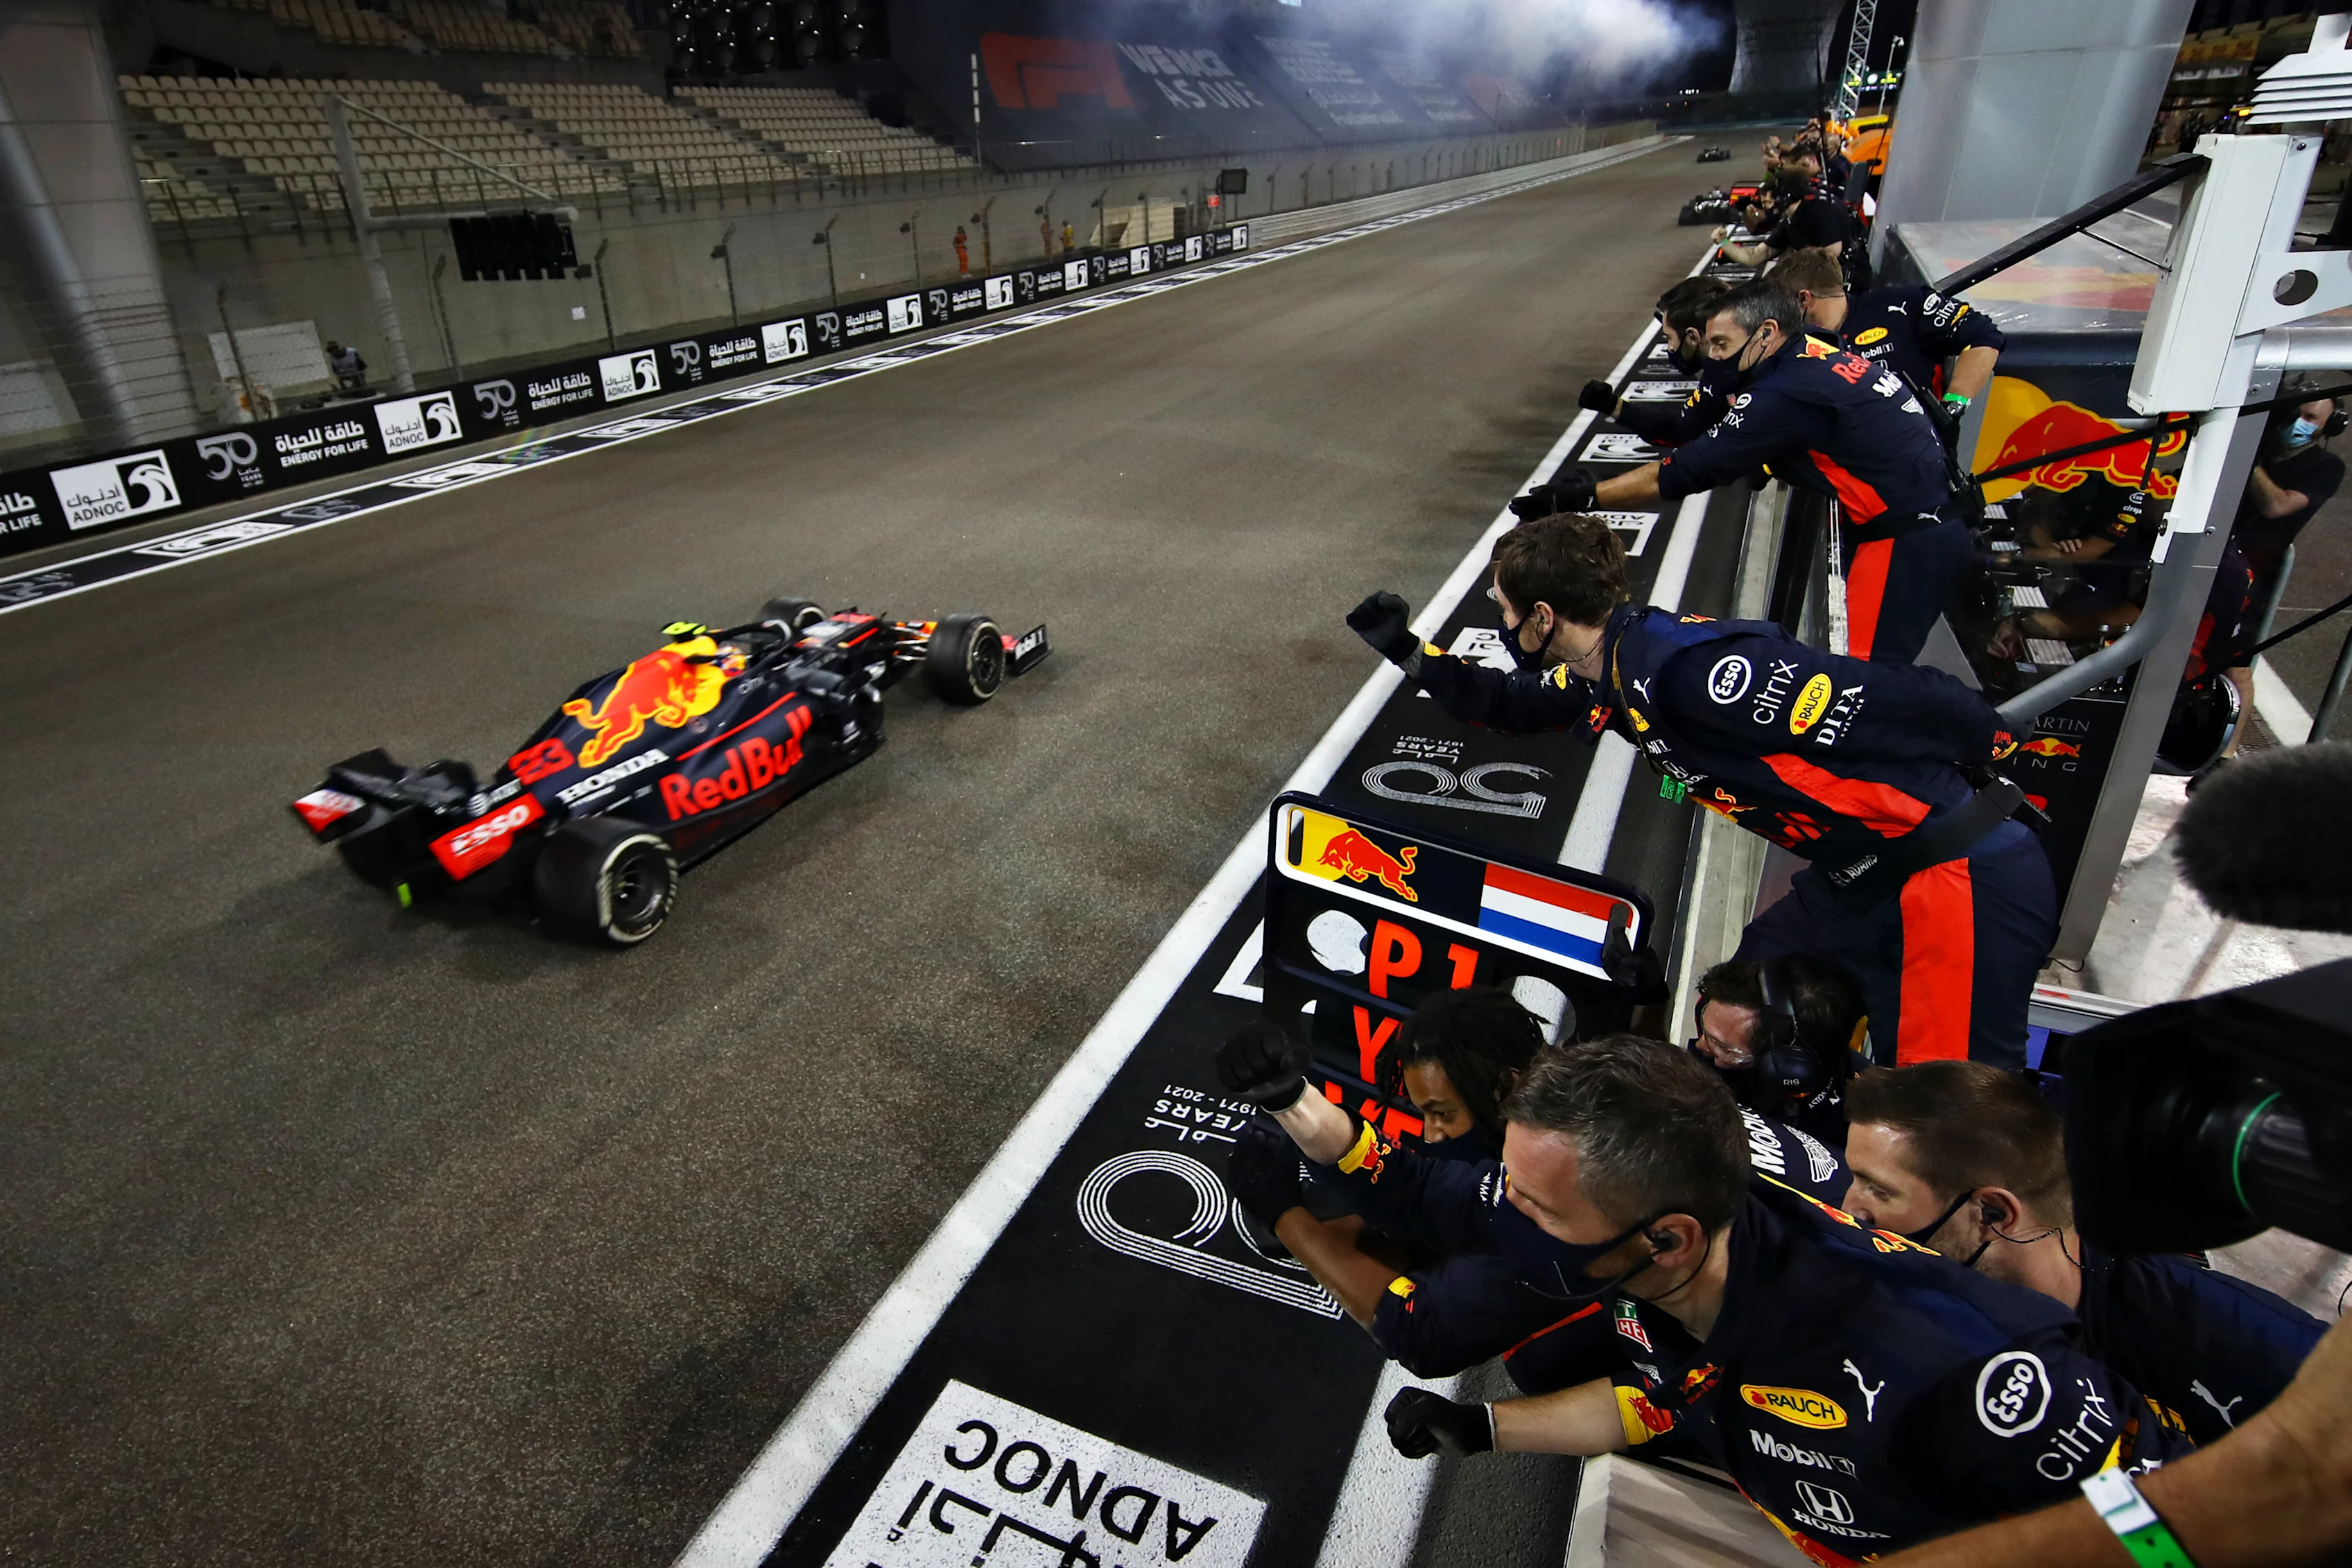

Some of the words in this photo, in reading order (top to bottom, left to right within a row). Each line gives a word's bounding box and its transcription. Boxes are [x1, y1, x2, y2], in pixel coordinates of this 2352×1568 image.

[1155, 78, 1207, 108] AS
[670, 340, 701, 375] 50
[711, 356, 734, 369] ENERGY
[734, 354, 745, 363] FOR
[746, 351, 758, 360] LIFE
[473, 379, 516, 419] 50
[531, 396, 562, 410] ENERGY
[562, 392, 577, 404] FOR
[578, 388, 594, 399] LIFE
[607, 383, 634, 398] ADNOC
[325, 420, 365, 442] طاقة
[389, 431, 425, 448] ADNOC
[196, 432, 259, 480] 50
[279, 451, 323, 468] ENERGY
[324, 444, 347, 458] FOR
[347, 438, 370, 453] LIFE
[9, 513, 43, 532] LIFE
[73, 500, 126, 523] ADNOC
[1753, 659, 1799, 724] citrix
[1799, 681, 1826, 720] RAUCH
[1815, 684, 1865, 746] DITA
[2034, 715, 2090, 733] ARTIN
[508, 738, 576, 785] 33
[1395, 741, 1460, 755] YEARS
[555, 748, 670, 804] HONDA
[1163, 1083, 1203, 1102] 2021
[1765, 1393, 1837, 1421] RAUCH
[2036, 1377, 2113, 1481] citrix
[1749, 1429, 1833, 1470] Mobil
[942, 1420, 1219, 1563] ADNOC
[1792, 1508, 1892, 1538] HONDA
